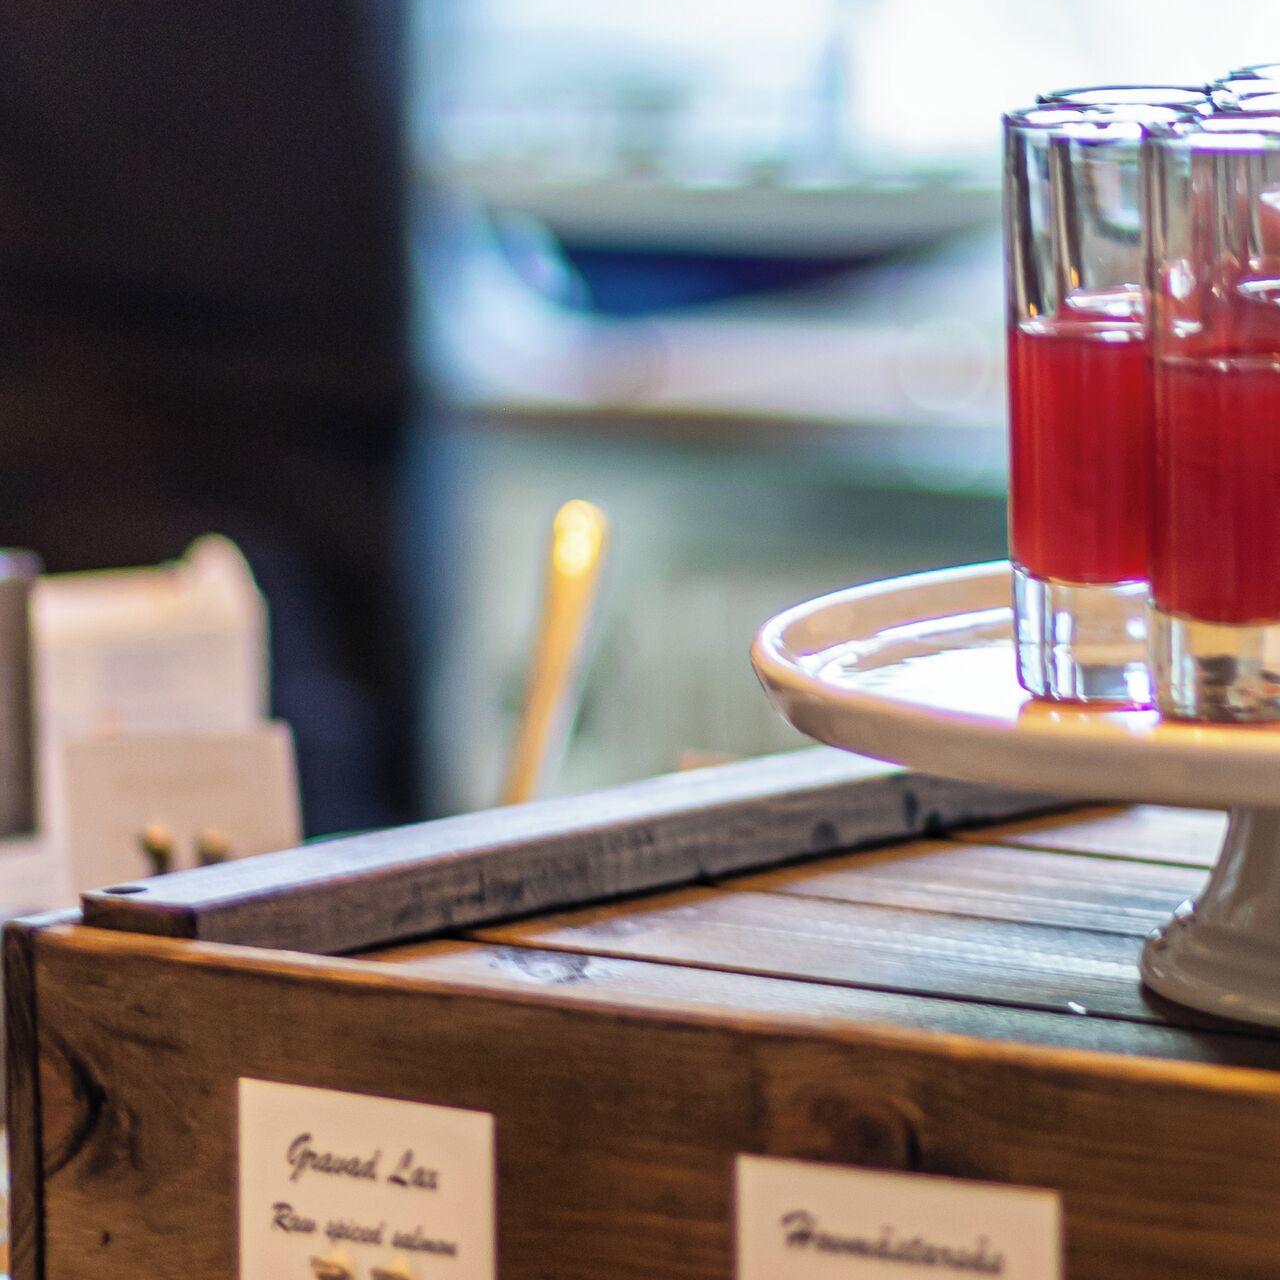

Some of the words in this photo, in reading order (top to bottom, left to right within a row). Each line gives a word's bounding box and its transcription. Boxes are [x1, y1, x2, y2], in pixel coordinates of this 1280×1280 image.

[287, 1132, 382, 1182] Gravad
[387, 1148, 439, 1190] Lax
[271, 1201, 316, 1234] Raw
